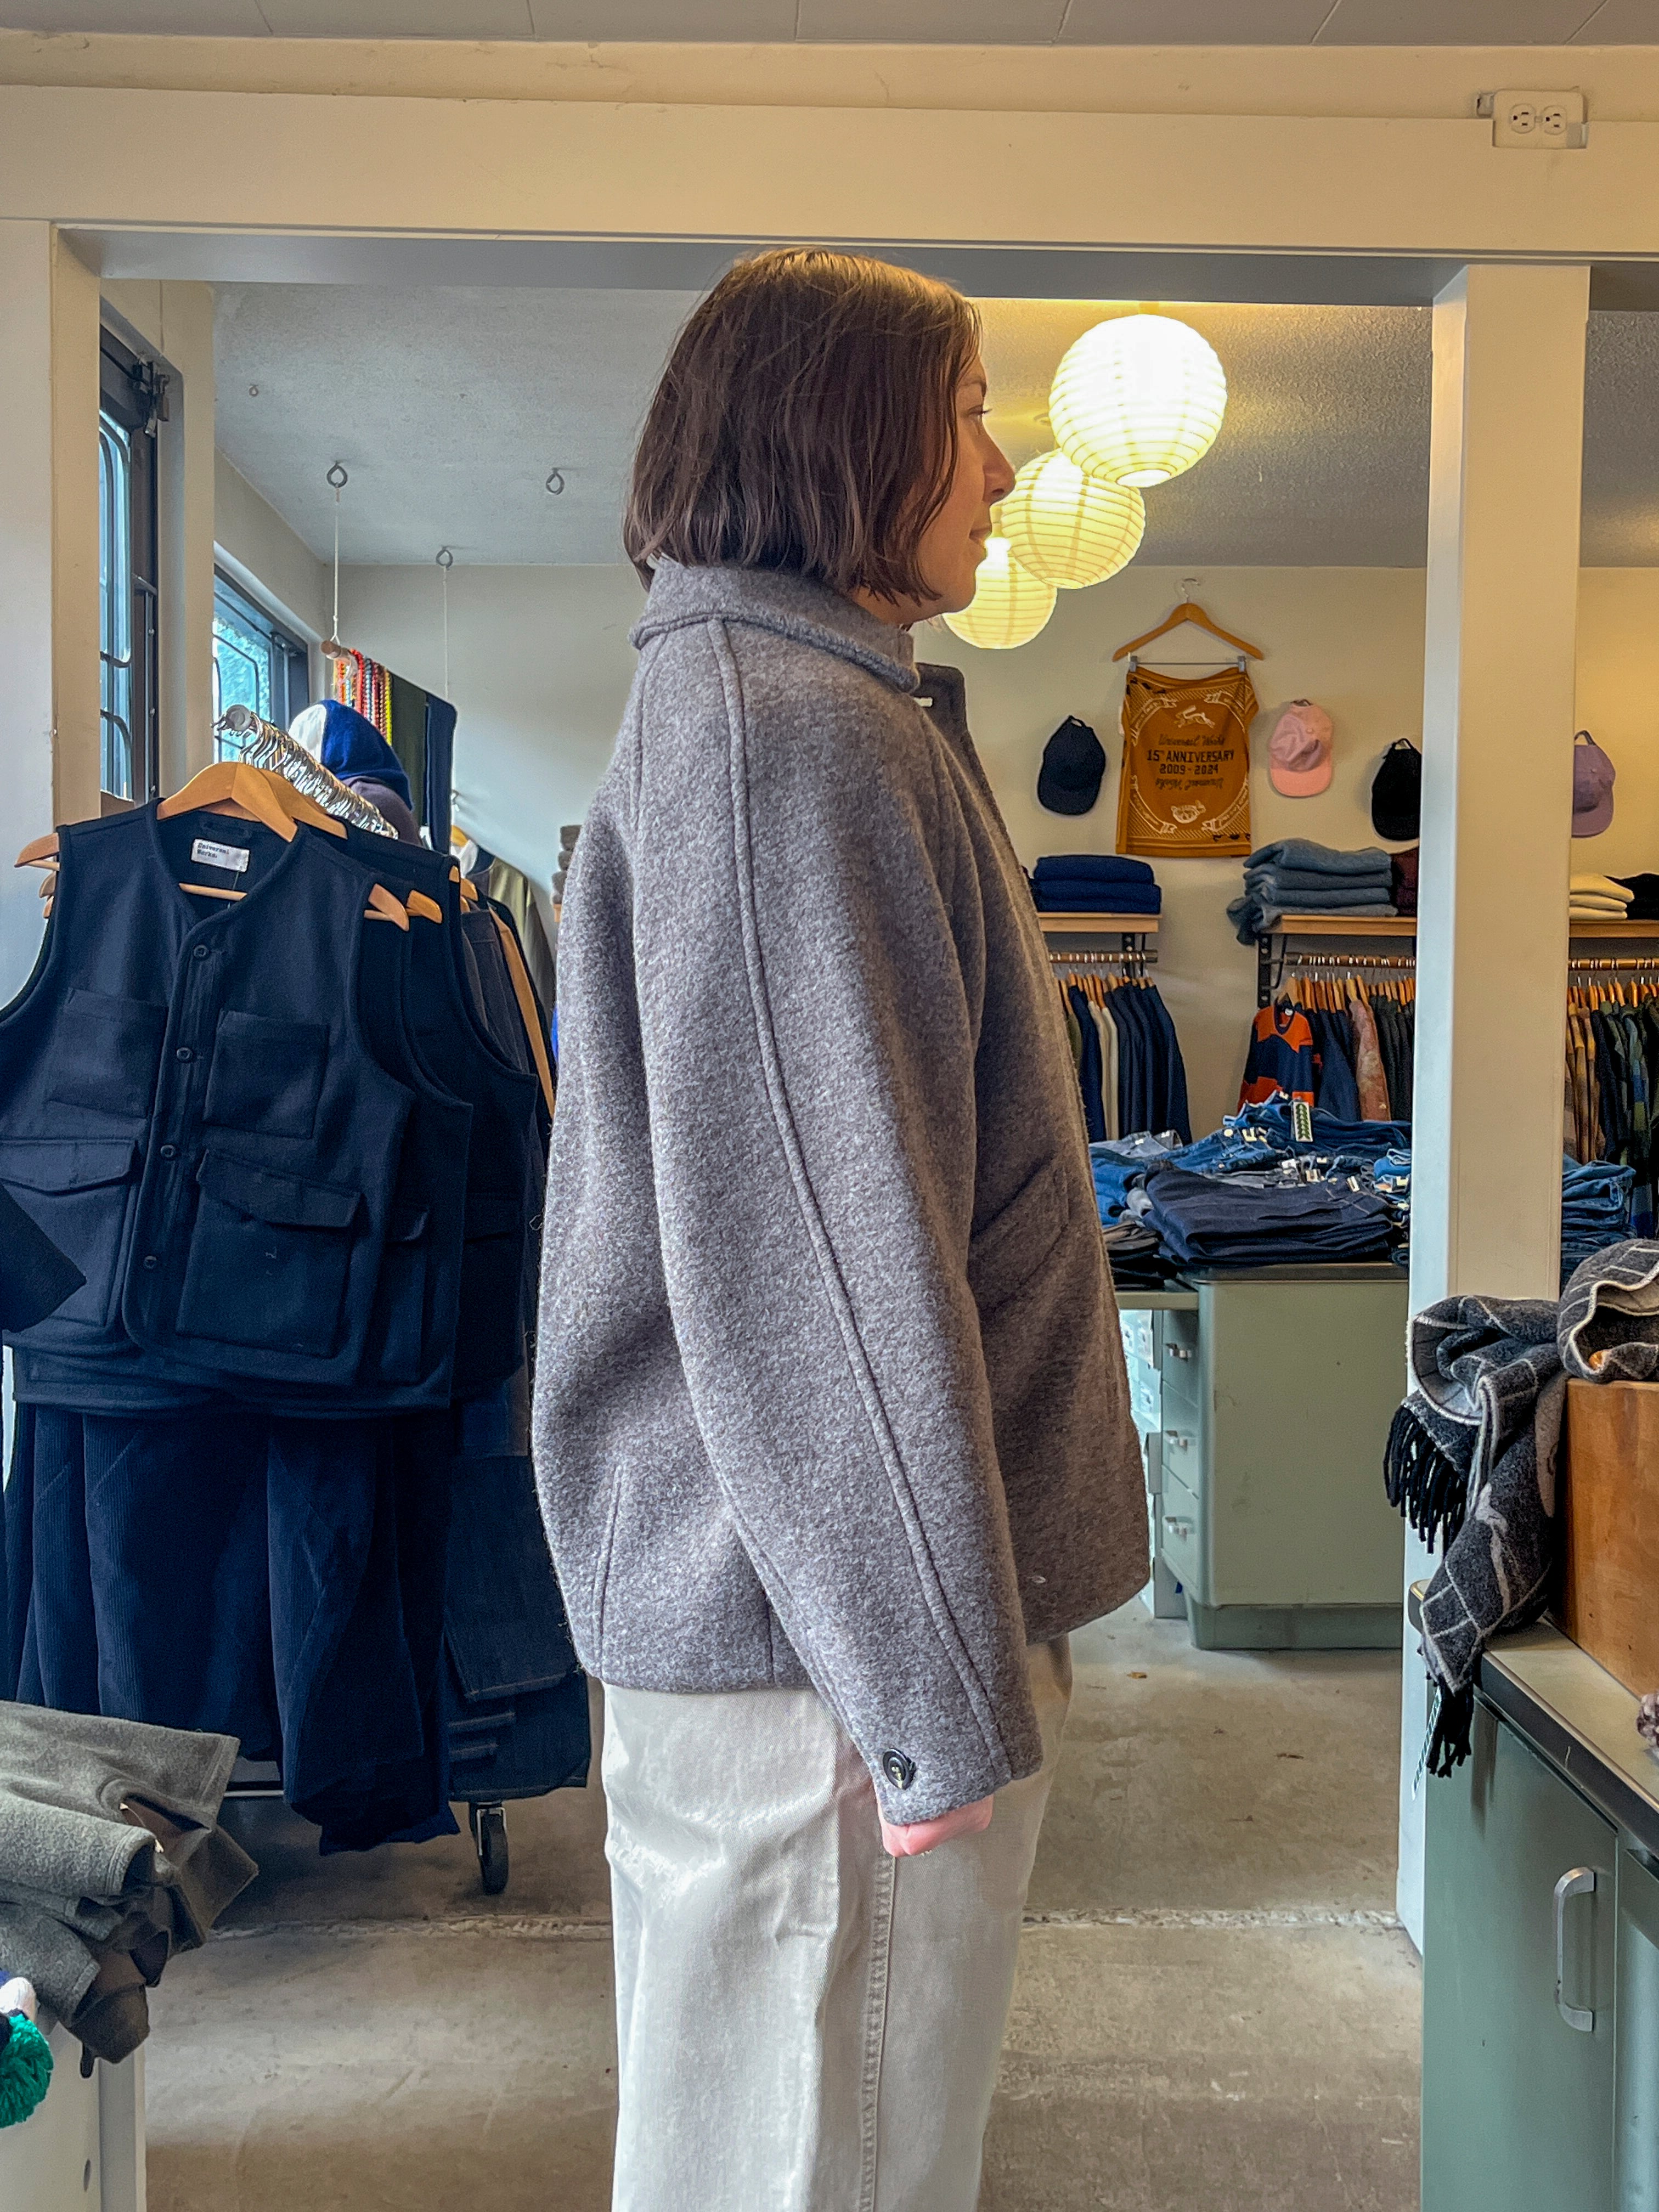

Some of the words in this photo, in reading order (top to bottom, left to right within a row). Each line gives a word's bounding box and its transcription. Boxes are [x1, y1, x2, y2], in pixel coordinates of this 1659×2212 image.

[1166, 749, 1234, 763] ANNIVERSARY
[1160, 764, 1186, 775] 2009
[1194, 764, 1218, 775] 2024
